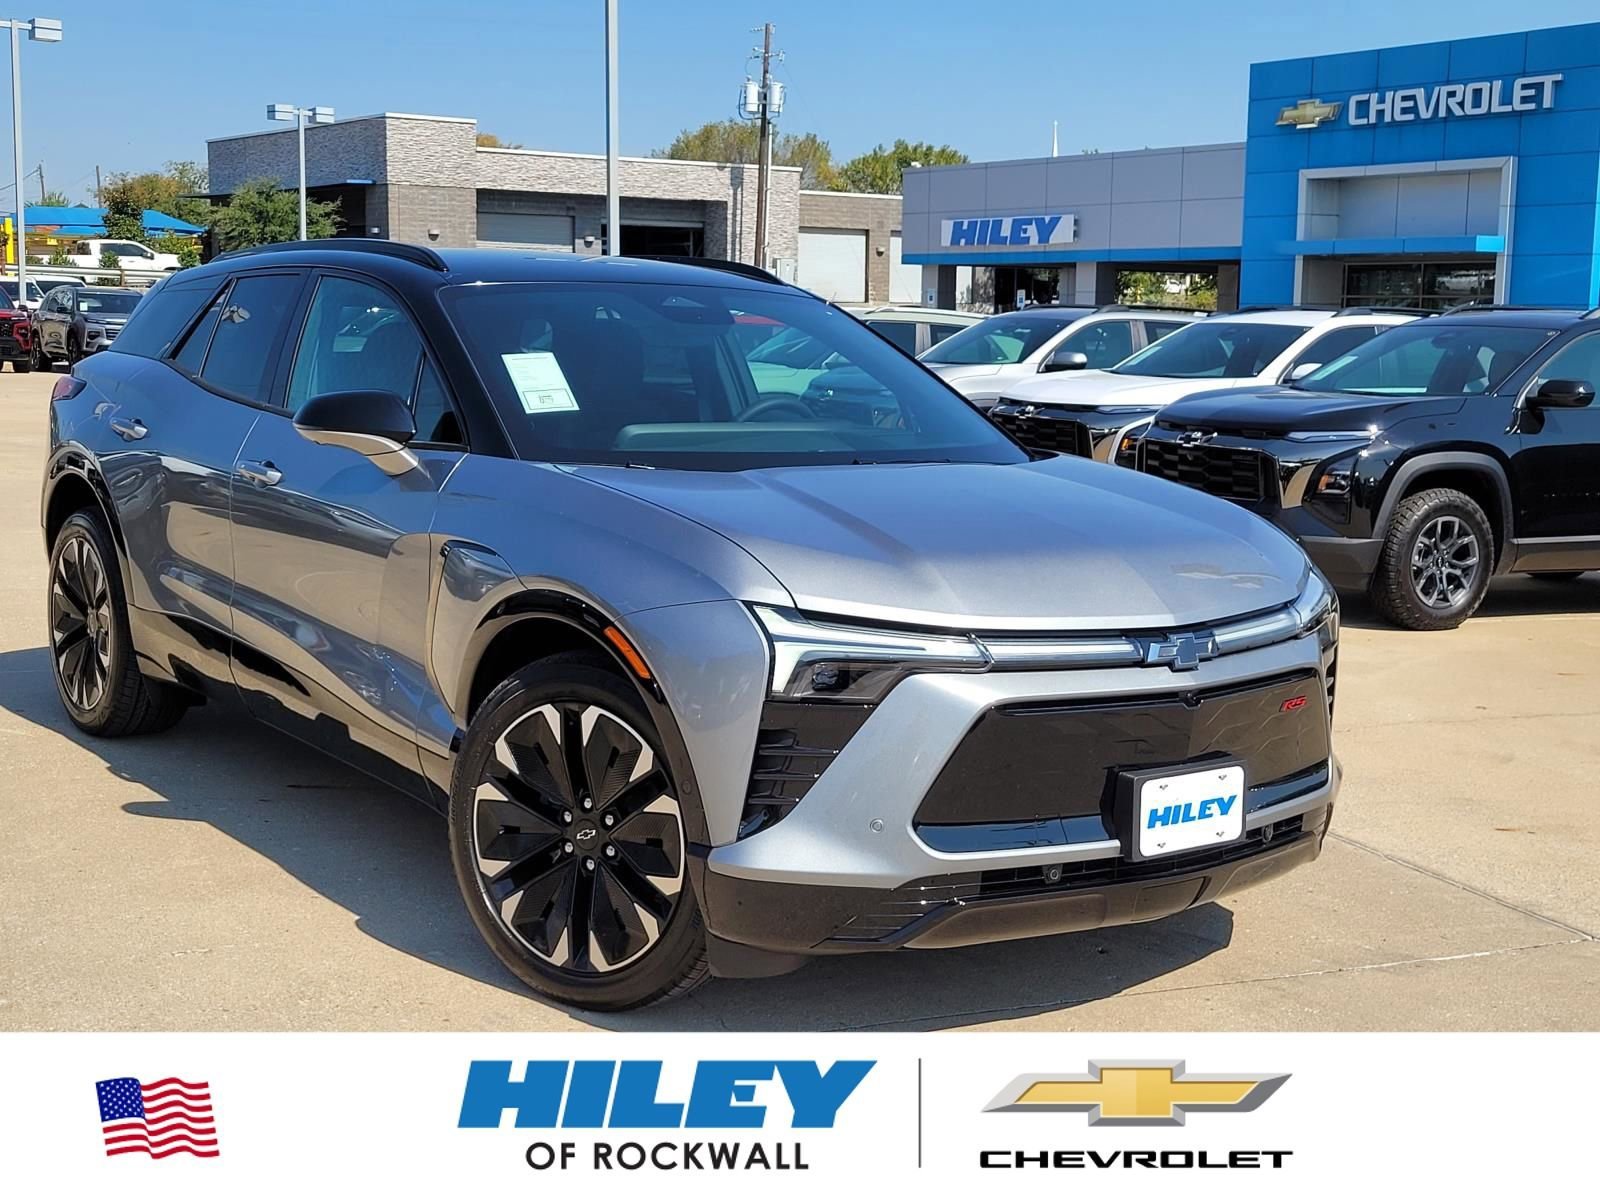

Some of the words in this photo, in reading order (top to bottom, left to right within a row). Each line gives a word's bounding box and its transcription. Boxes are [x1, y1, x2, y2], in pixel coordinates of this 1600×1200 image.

[1348, 73, 1564, 126] CHEVROLET
[950, 215, 1062, 246] HILEY
[1279, 695, 1307, 712] RS
[1147, 795, 1237, 829] HILEY
